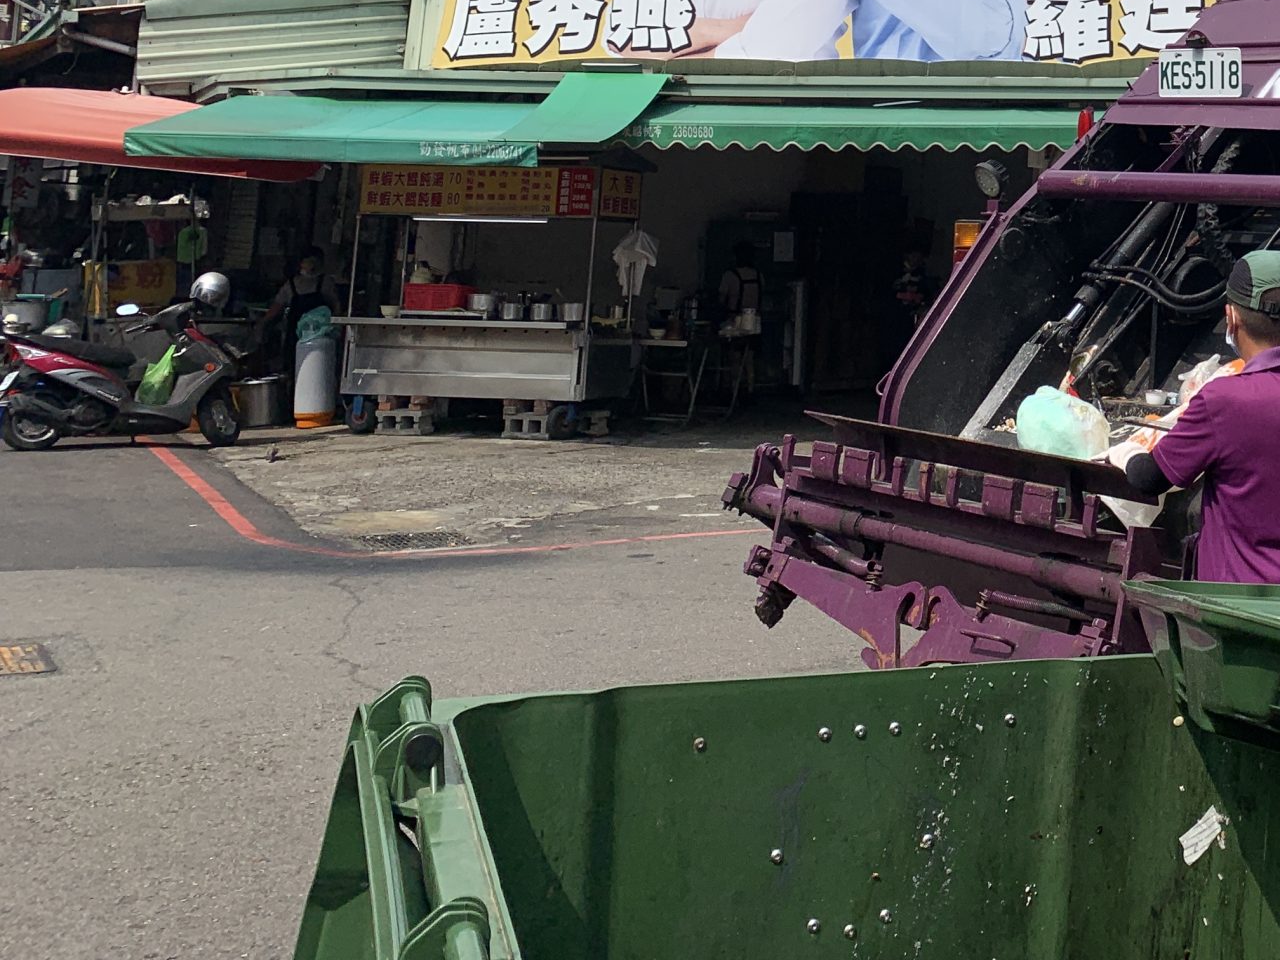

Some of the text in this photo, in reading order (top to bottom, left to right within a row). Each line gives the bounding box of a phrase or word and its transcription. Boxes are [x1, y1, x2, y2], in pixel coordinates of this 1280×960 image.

[672, 125, 714, 138] 23609680
[449, 172, 462, 185] 70
[447, 192, 460, 206] 80
